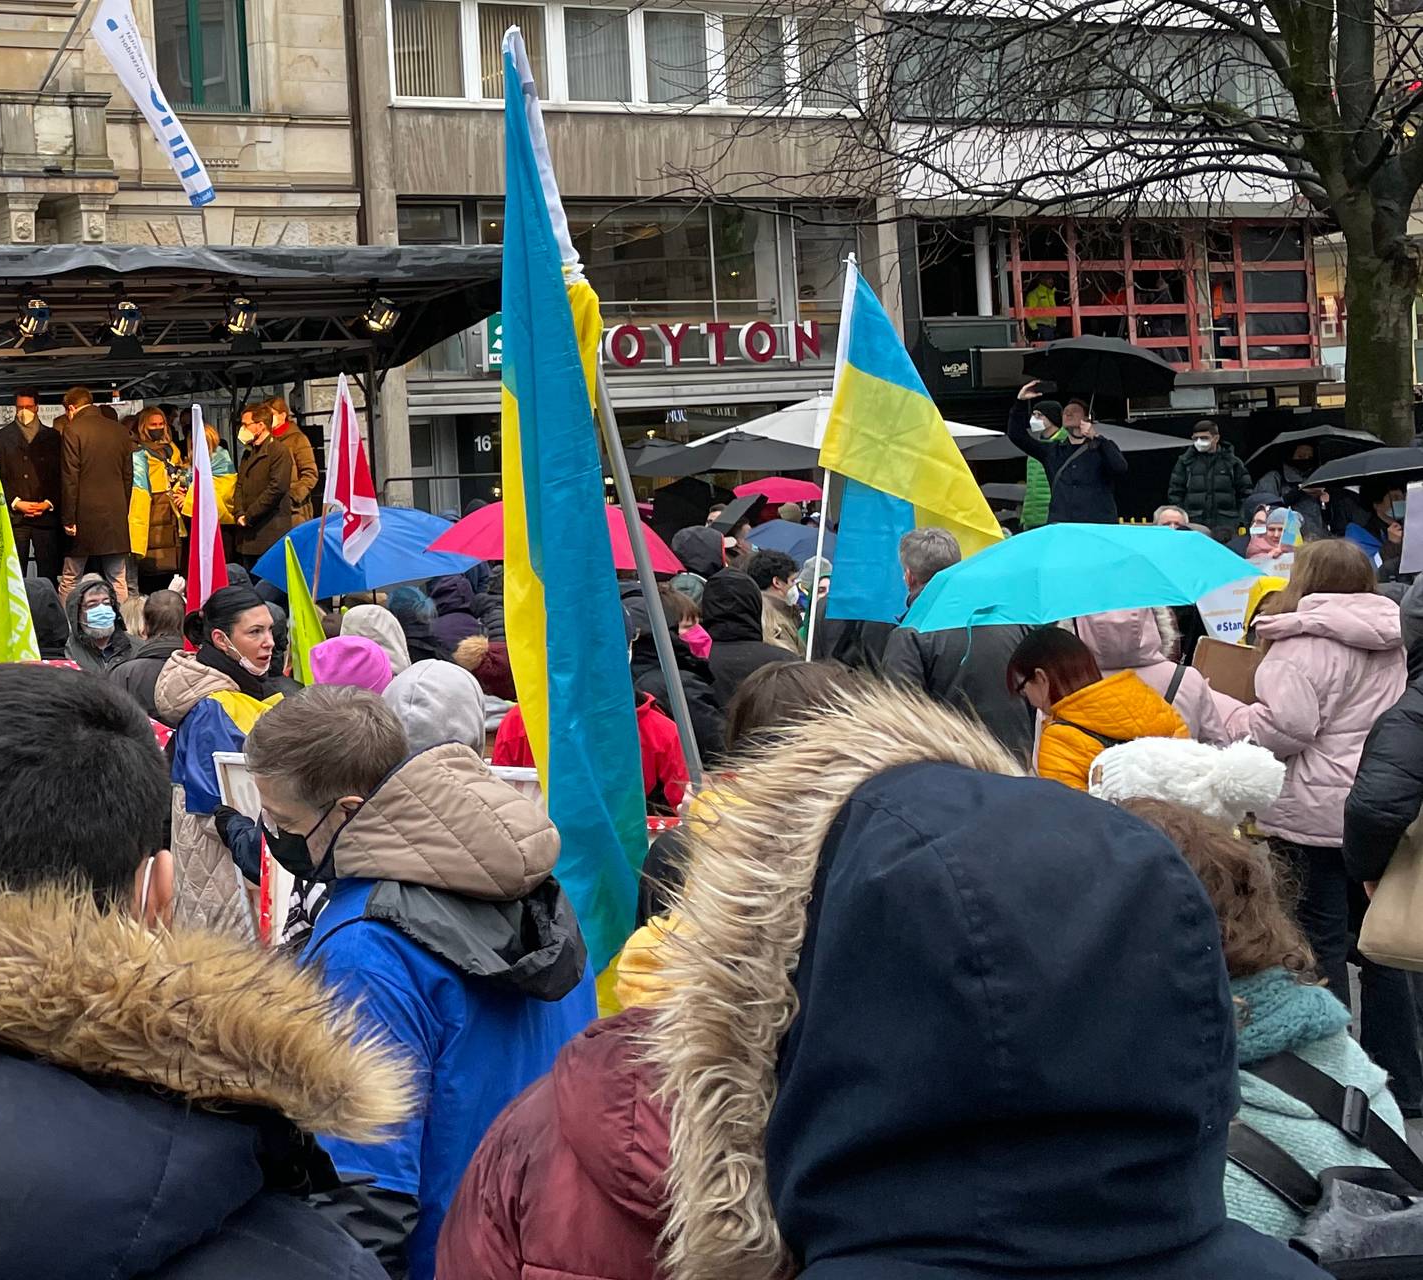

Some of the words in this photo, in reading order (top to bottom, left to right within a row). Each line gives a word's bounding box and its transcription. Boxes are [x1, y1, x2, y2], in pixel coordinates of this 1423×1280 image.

[604, 320, 821, 368] OYTON
[474, 435, 492, 451] 16
[1216, 621, 1243, 631] #Stan
